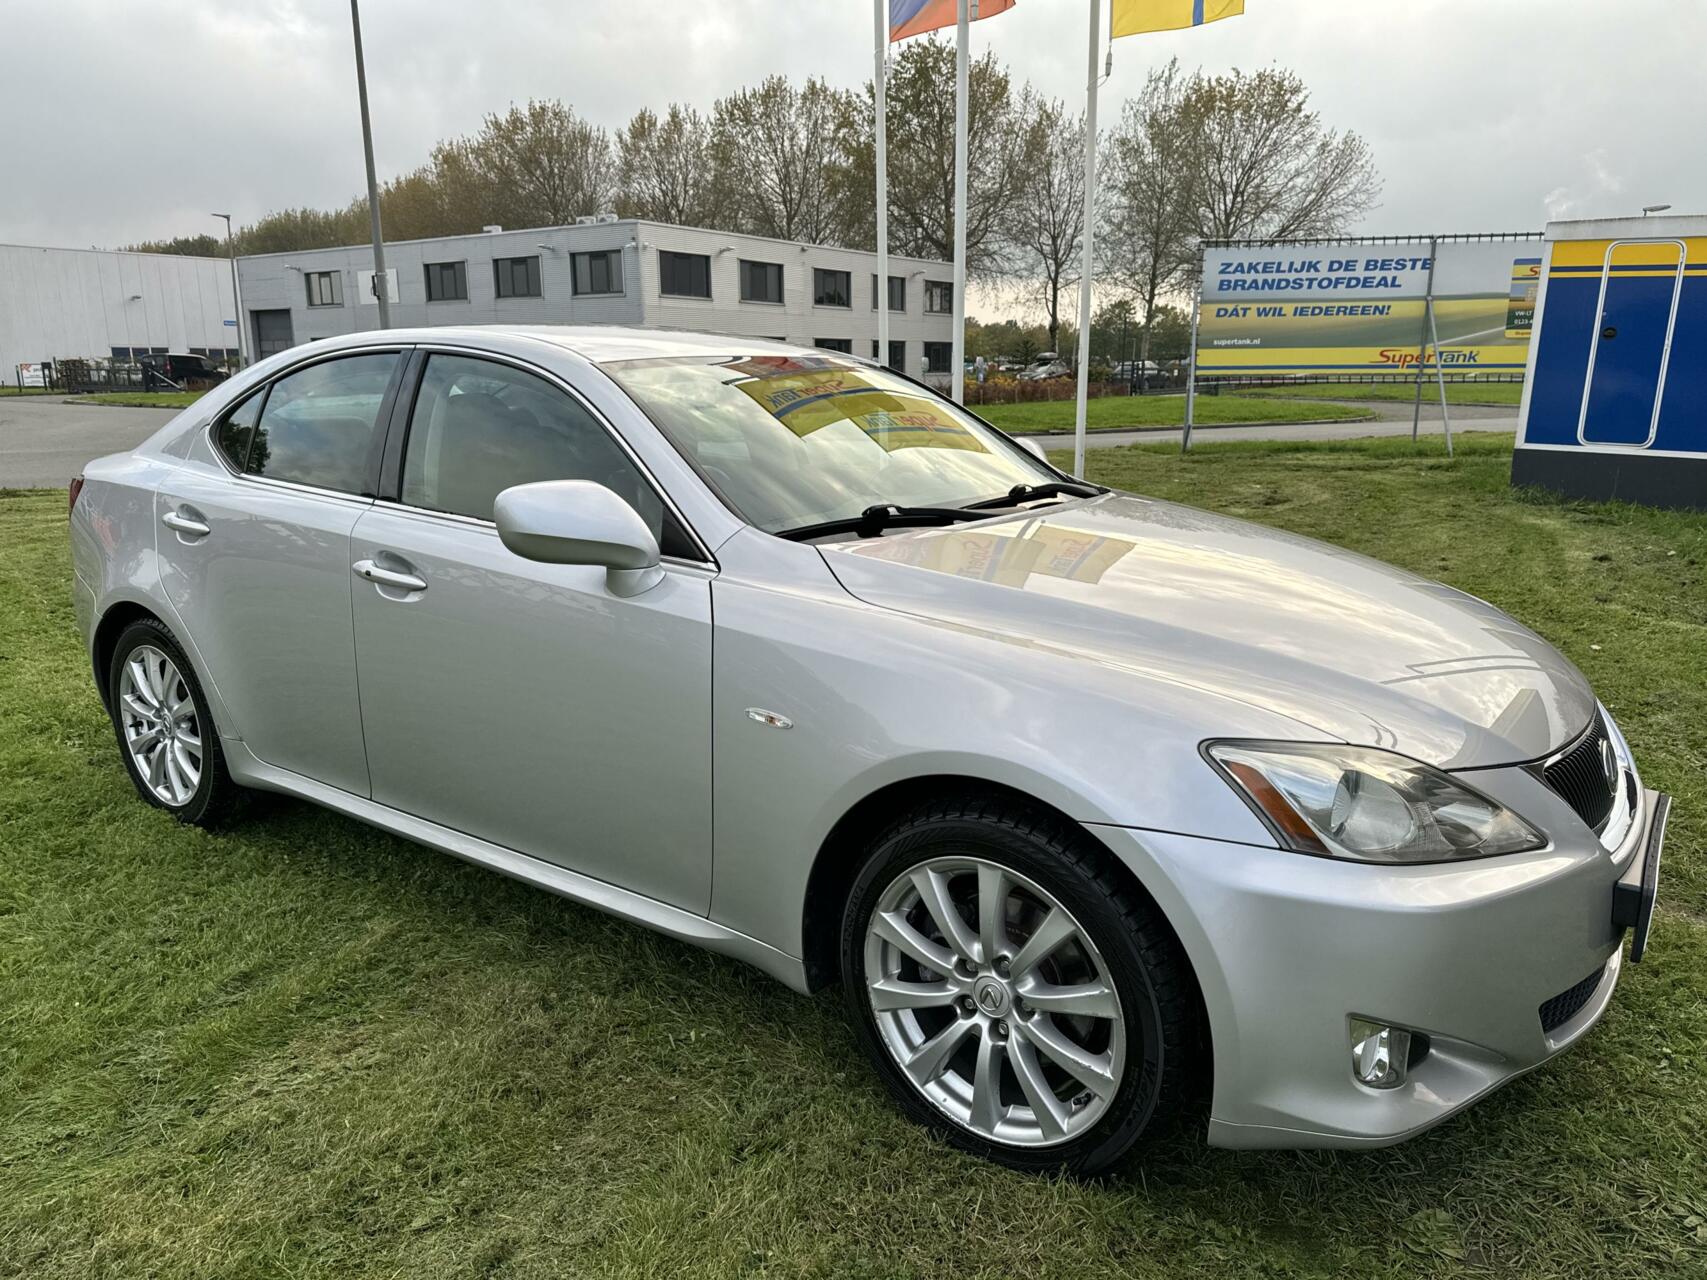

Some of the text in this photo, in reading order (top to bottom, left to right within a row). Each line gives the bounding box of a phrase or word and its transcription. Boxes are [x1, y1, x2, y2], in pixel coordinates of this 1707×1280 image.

[1218, 257, 1436, 275] ZAKELIJK DE BESTE
[1217, 275, 1402, 291] BRANDSTOFDEAL
[1215, 304, 1392, 318] DÁT WIL IEDEREEN!
[1213, 338, 1261, 346] supertank.nl
